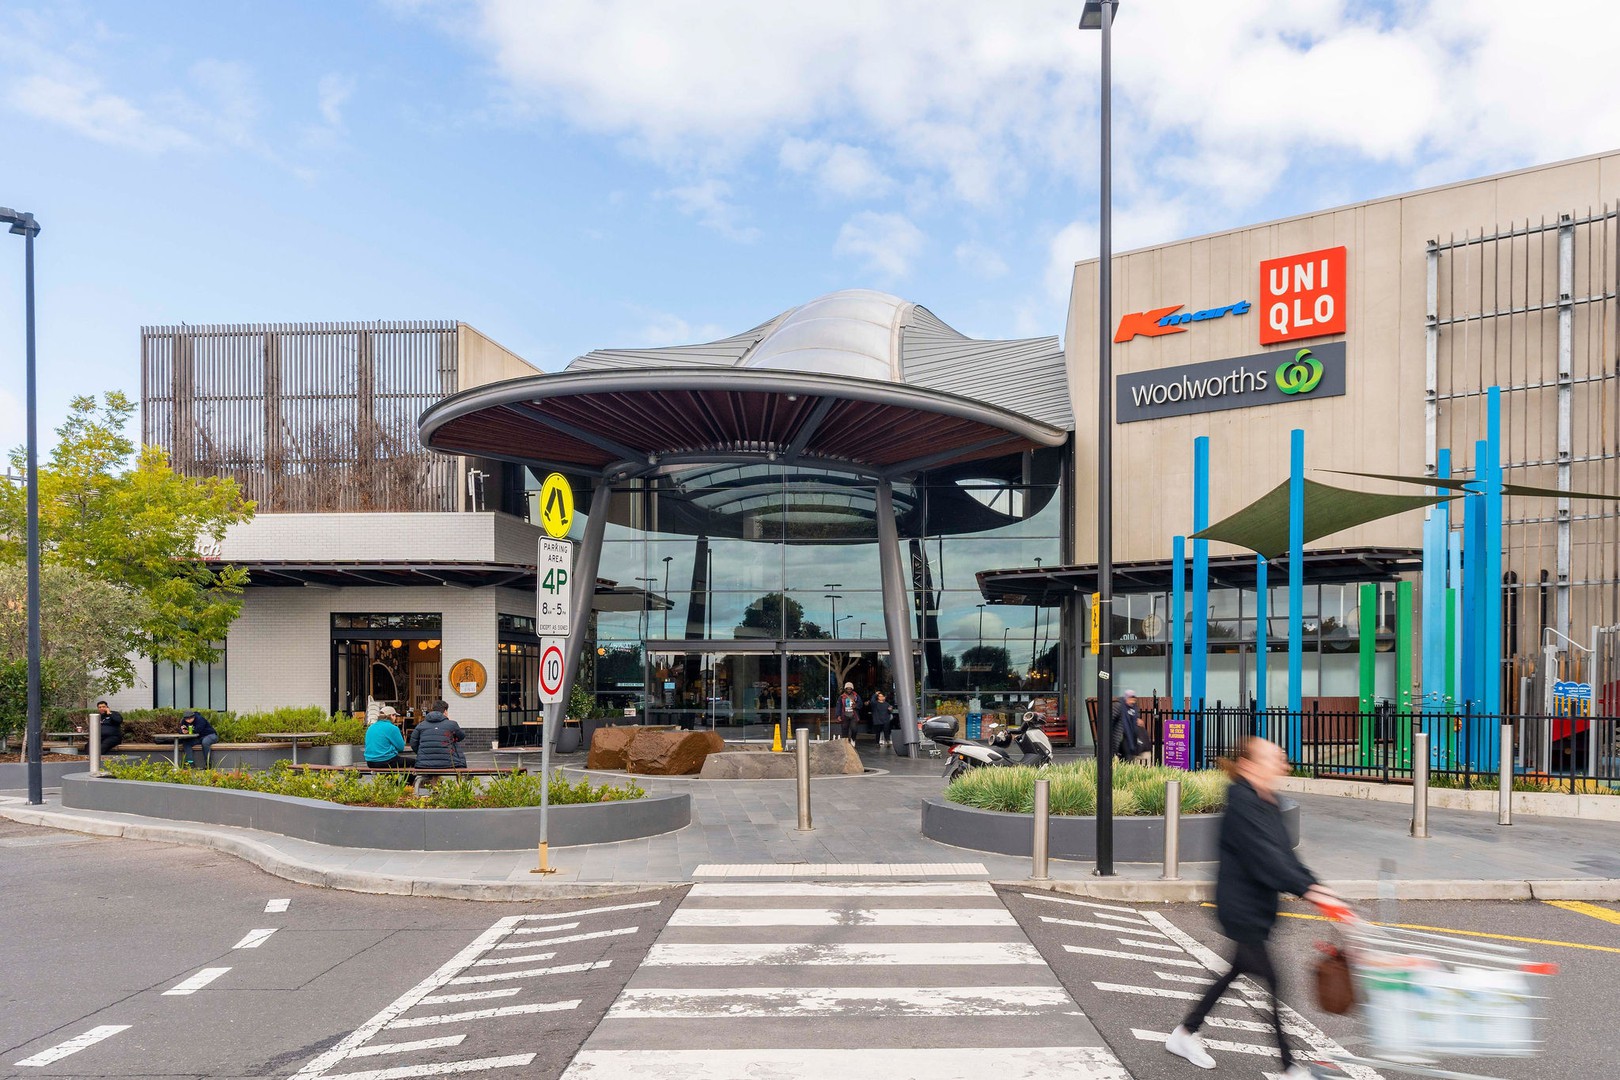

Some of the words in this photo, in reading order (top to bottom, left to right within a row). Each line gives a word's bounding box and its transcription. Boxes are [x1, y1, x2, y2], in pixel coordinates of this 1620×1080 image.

[1269, 259, 1329, 296] UNI
[1113, 300, 1252, 344] Kmart
[1268, 294, 1335, 335] QLO
[1131, 366, 1268, 407] Woolworths
[543, 542, 568, 554] PARKING
[547, 554, 564, 563] AREA
[542, 568, 568, 595] 4P
[547, 659, 559, 681] 10
